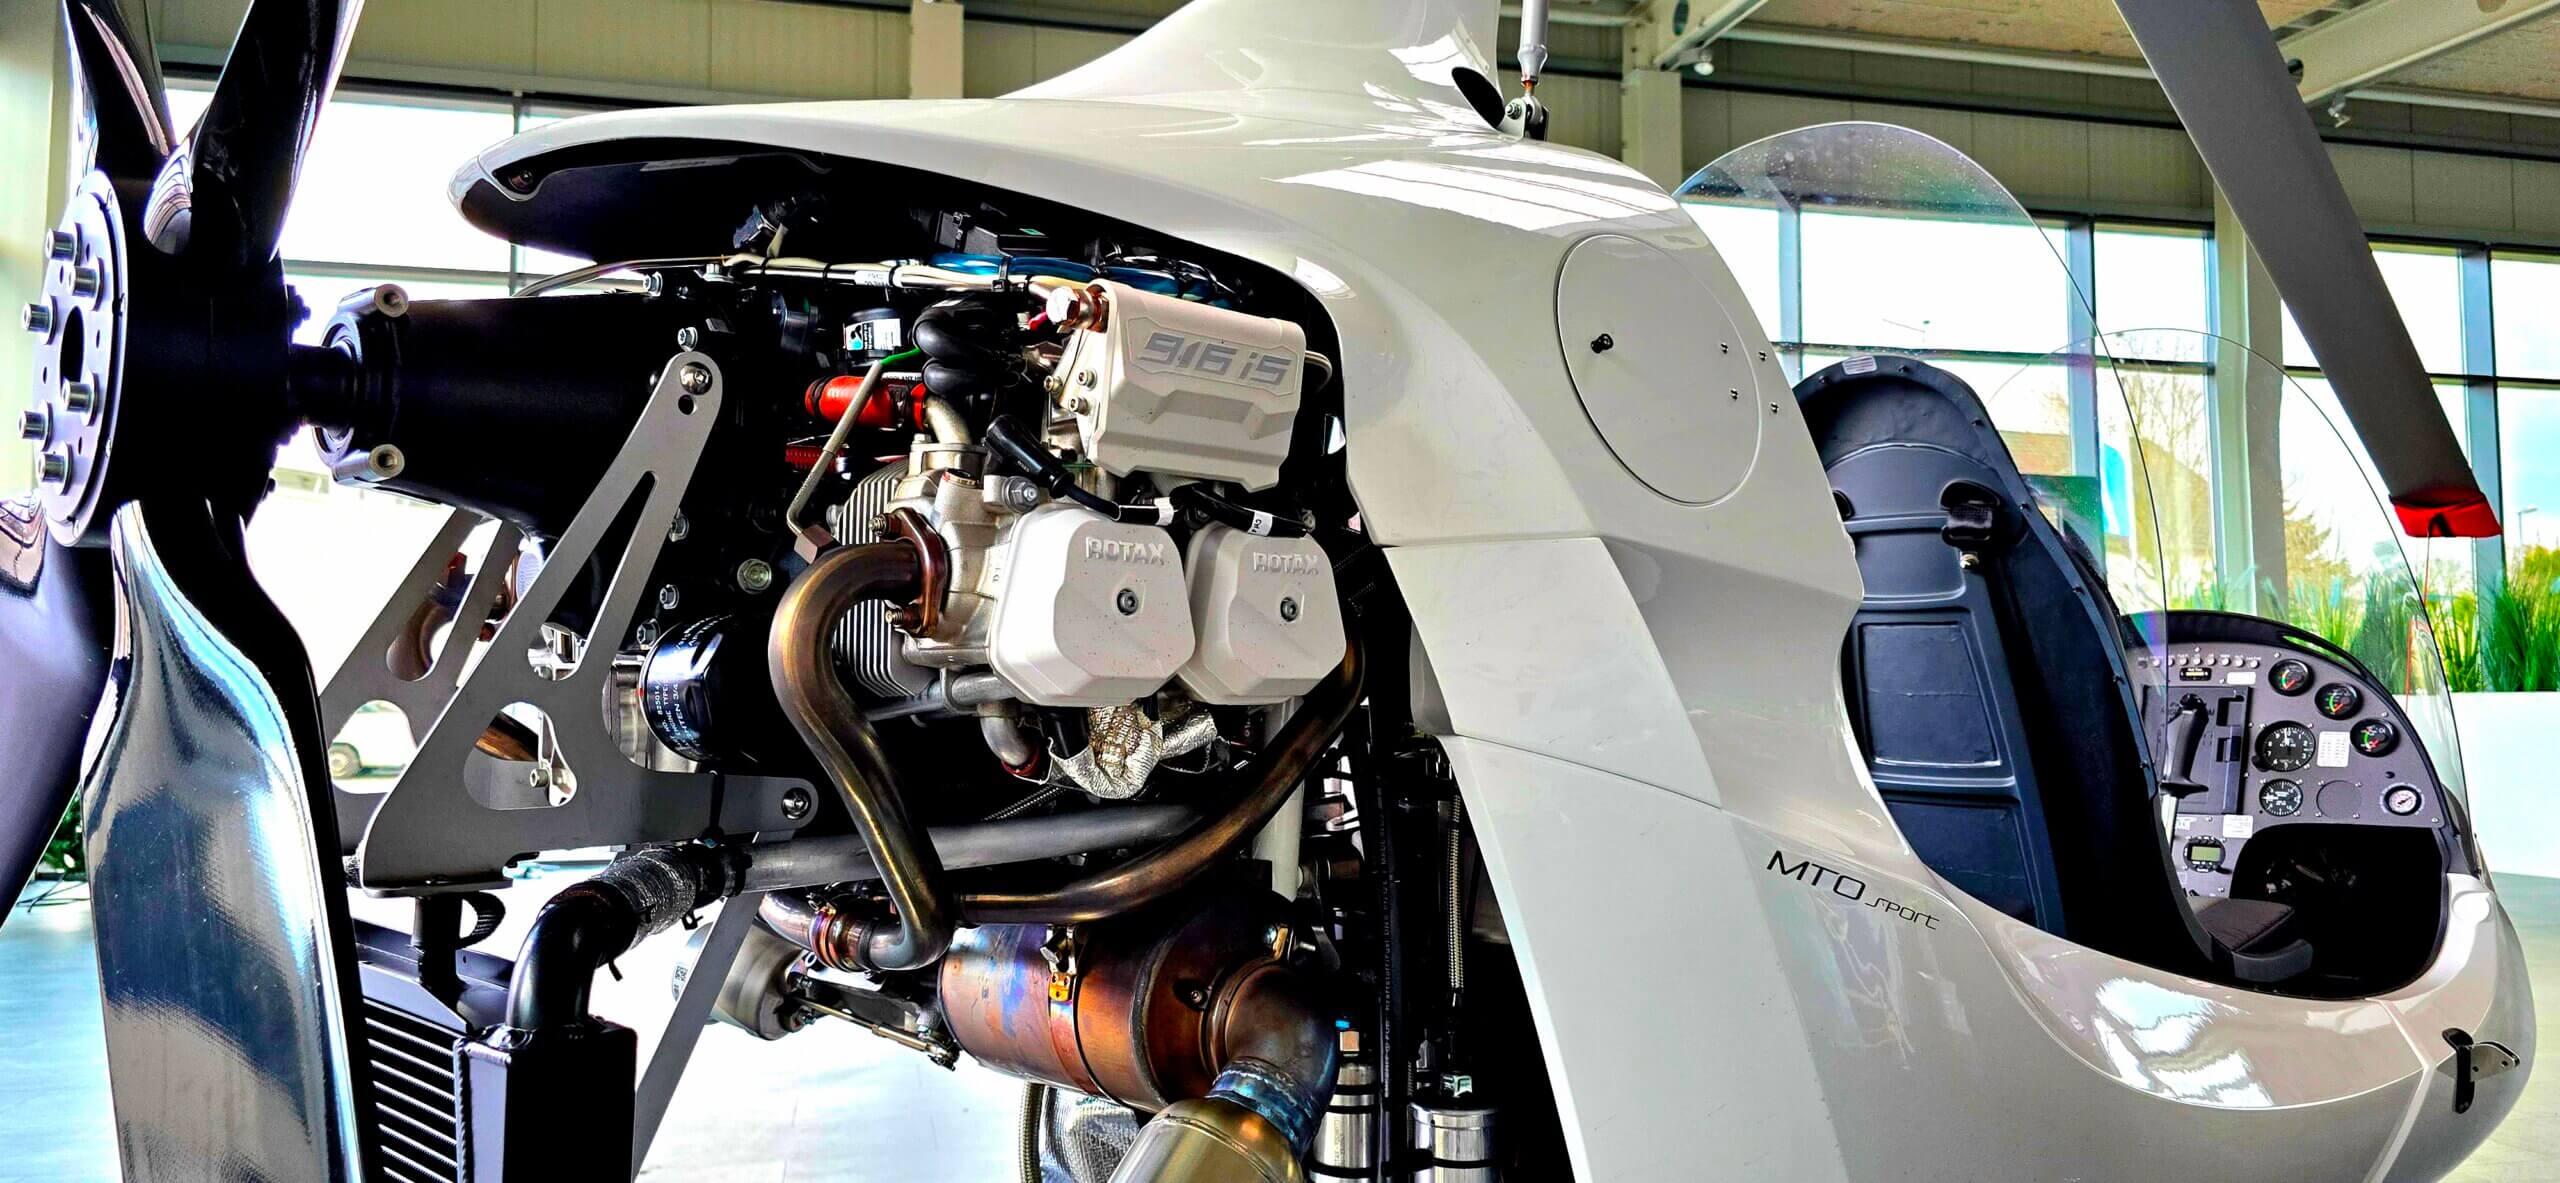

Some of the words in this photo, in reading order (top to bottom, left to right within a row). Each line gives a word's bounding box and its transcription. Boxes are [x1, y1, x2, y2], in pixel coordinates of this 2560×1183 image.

[1138, 332, 1238, 376] 916
[1085, 536, 1165, 566] ROTAX
[1253, 552, 1319, 576] ROTAX
[1766, 850, 1866, 901] MTO
